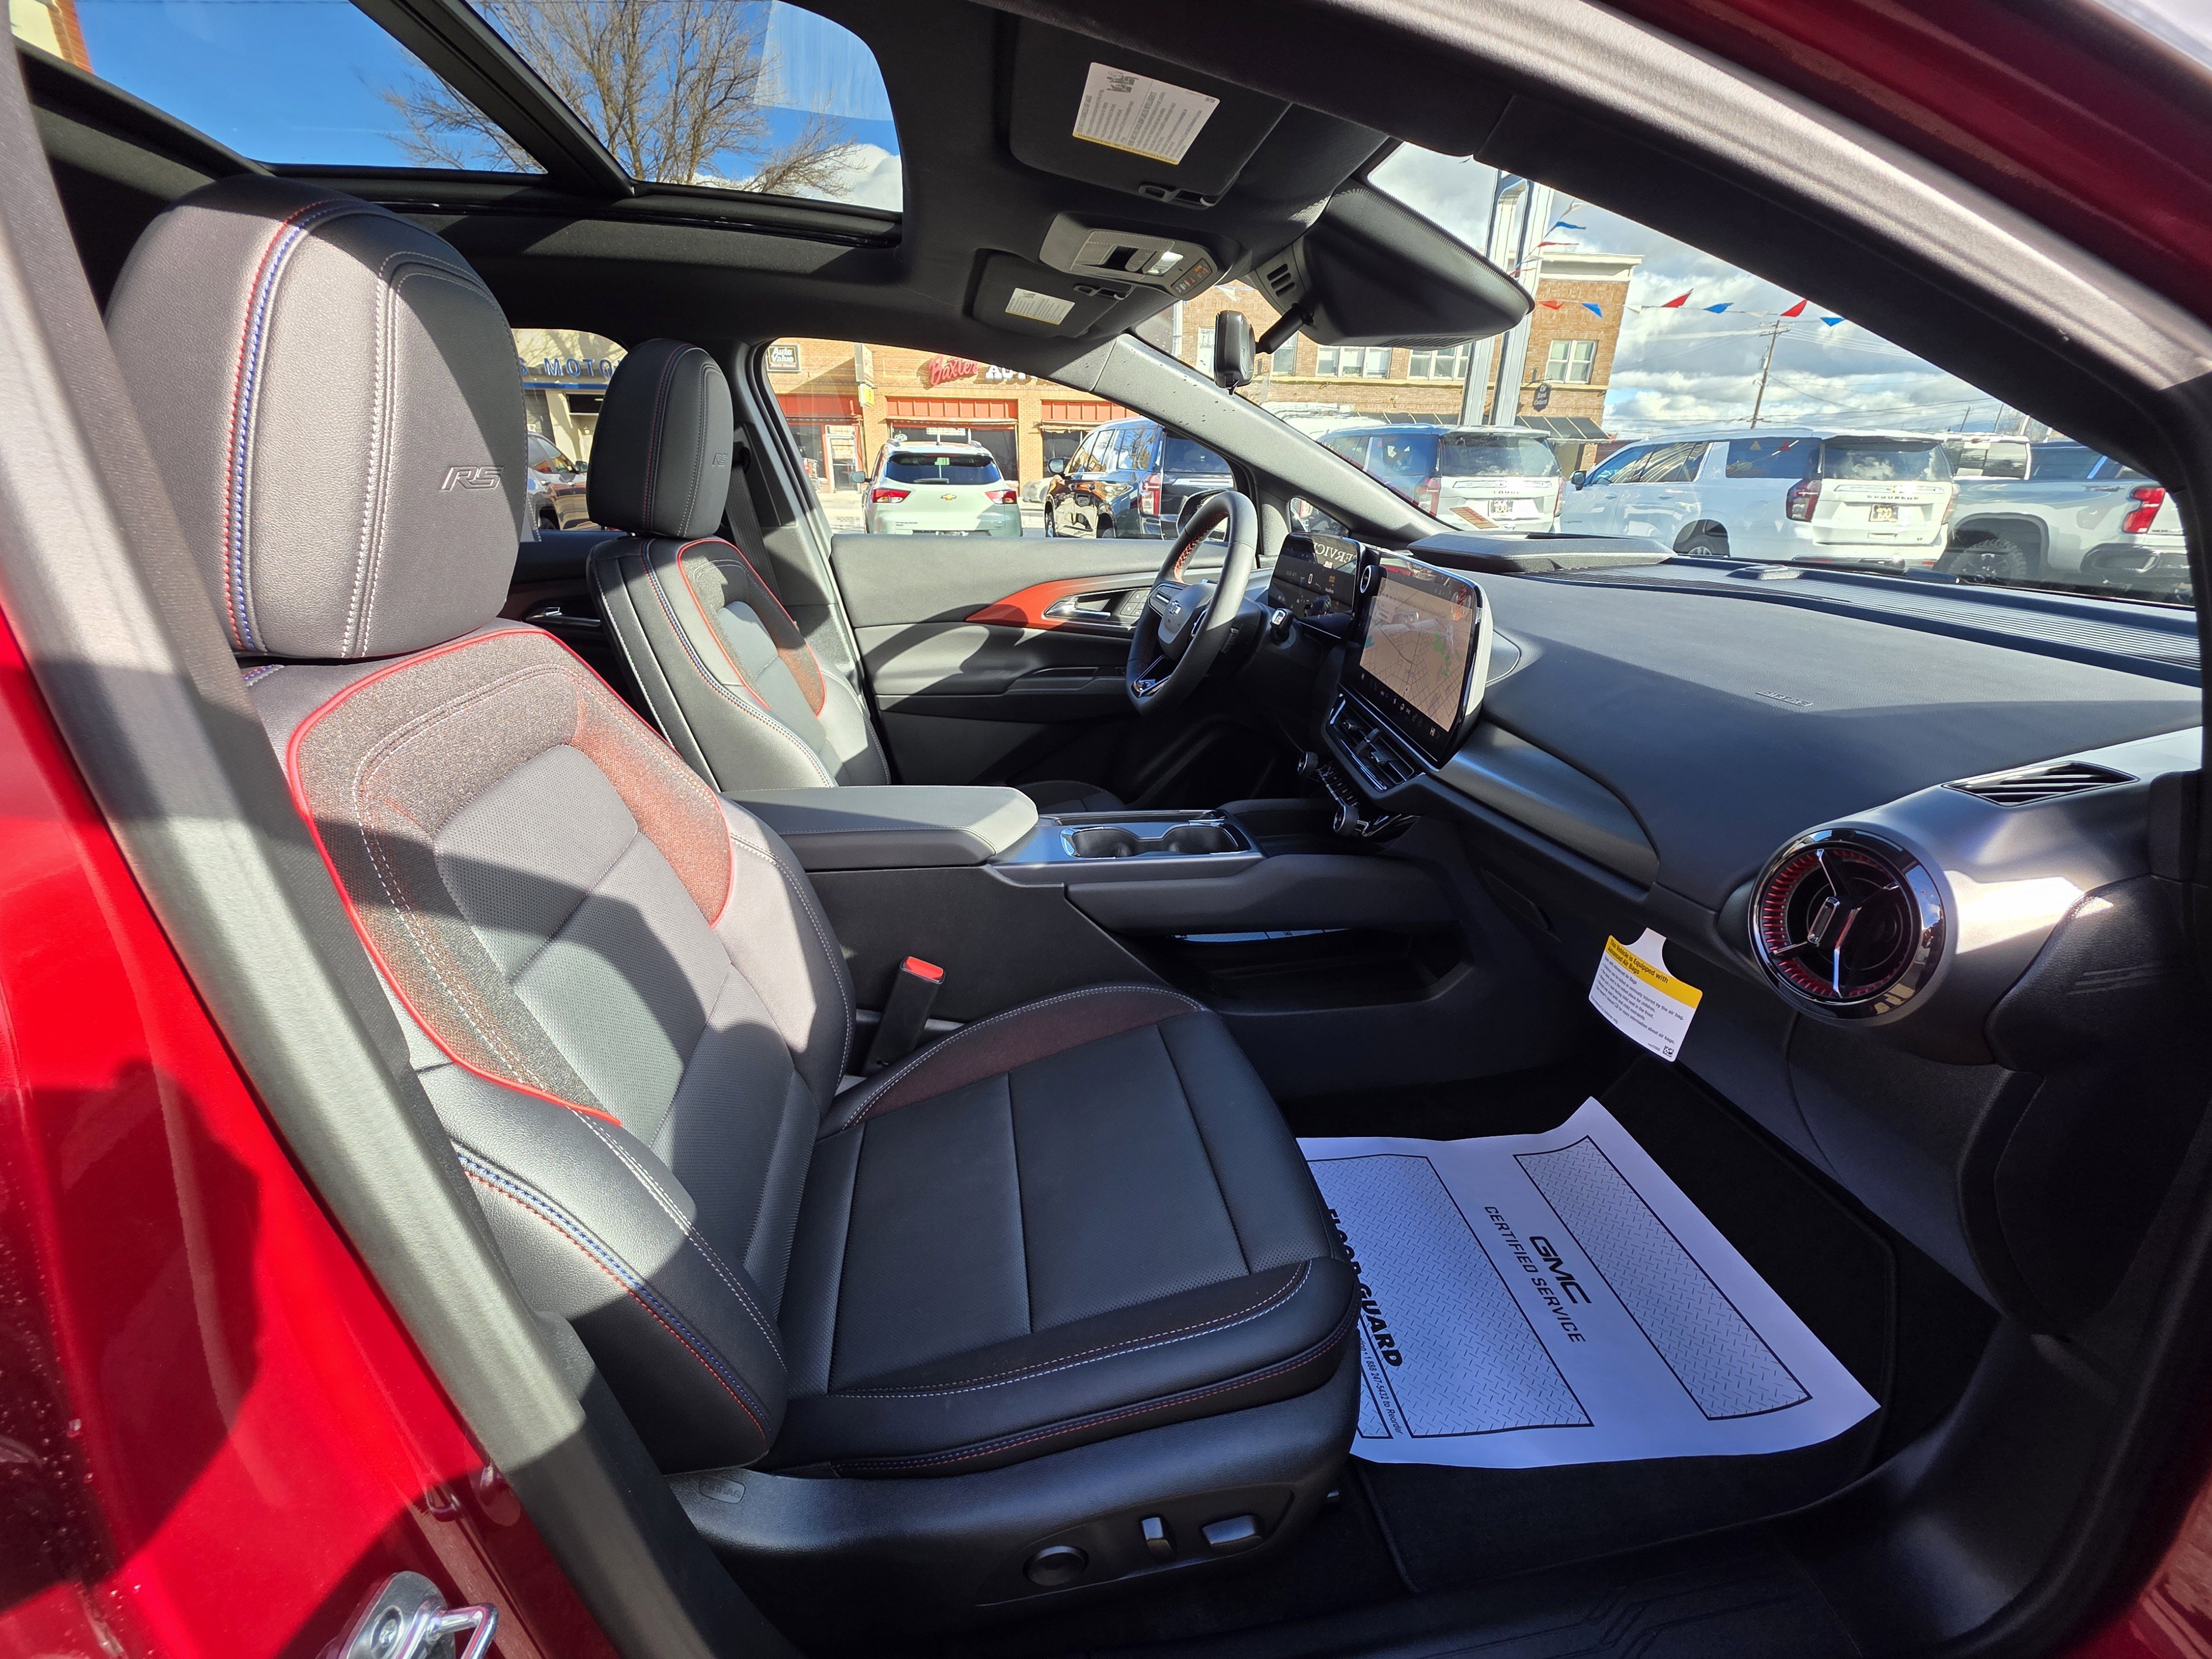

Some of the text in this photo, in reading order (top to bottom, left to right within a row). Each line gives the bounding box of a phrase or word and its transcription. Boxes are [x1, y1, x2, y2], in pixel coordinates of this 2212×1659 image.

[771, 354, 794, 363] Value
[774, 347, 792, 356] Auto
[544, 357, 621, 378] MOTO
[929, 354, 1039, 386] Baxter AU
[441, 465, 504, 491] RS
[1608, 946, 1623, 962] Advanced
[1629, 963, 1640, 975] Bags
[1616, 945, 1629, 958] Vehicle
[1633, 958, 1656, 976] Equipped
[1656, 973, 1669, 984] with
[1629, 986, 1643, 998] seriously
[1643, 994, 1656, 1005] injured
[1641, 1001, 1655, 1013] children.
[1630, 1015, 1647, 1029] information
[1647, 1027, 1658, 1035] about
[1664, 1035, 1674, 1044] bags.
[1484, 1206, 1586, 1343] CERTIFIED SERVICE
[1529, 1236, 1592, 1304] GMC
[1360, 1282, 1403, 1366] GUARD
[1366, 1361, 1377, 1371] 888
[1370, 1373, 1389, 1400] 247-5432
[1386, 1408, 1404, 1435] Reorder
